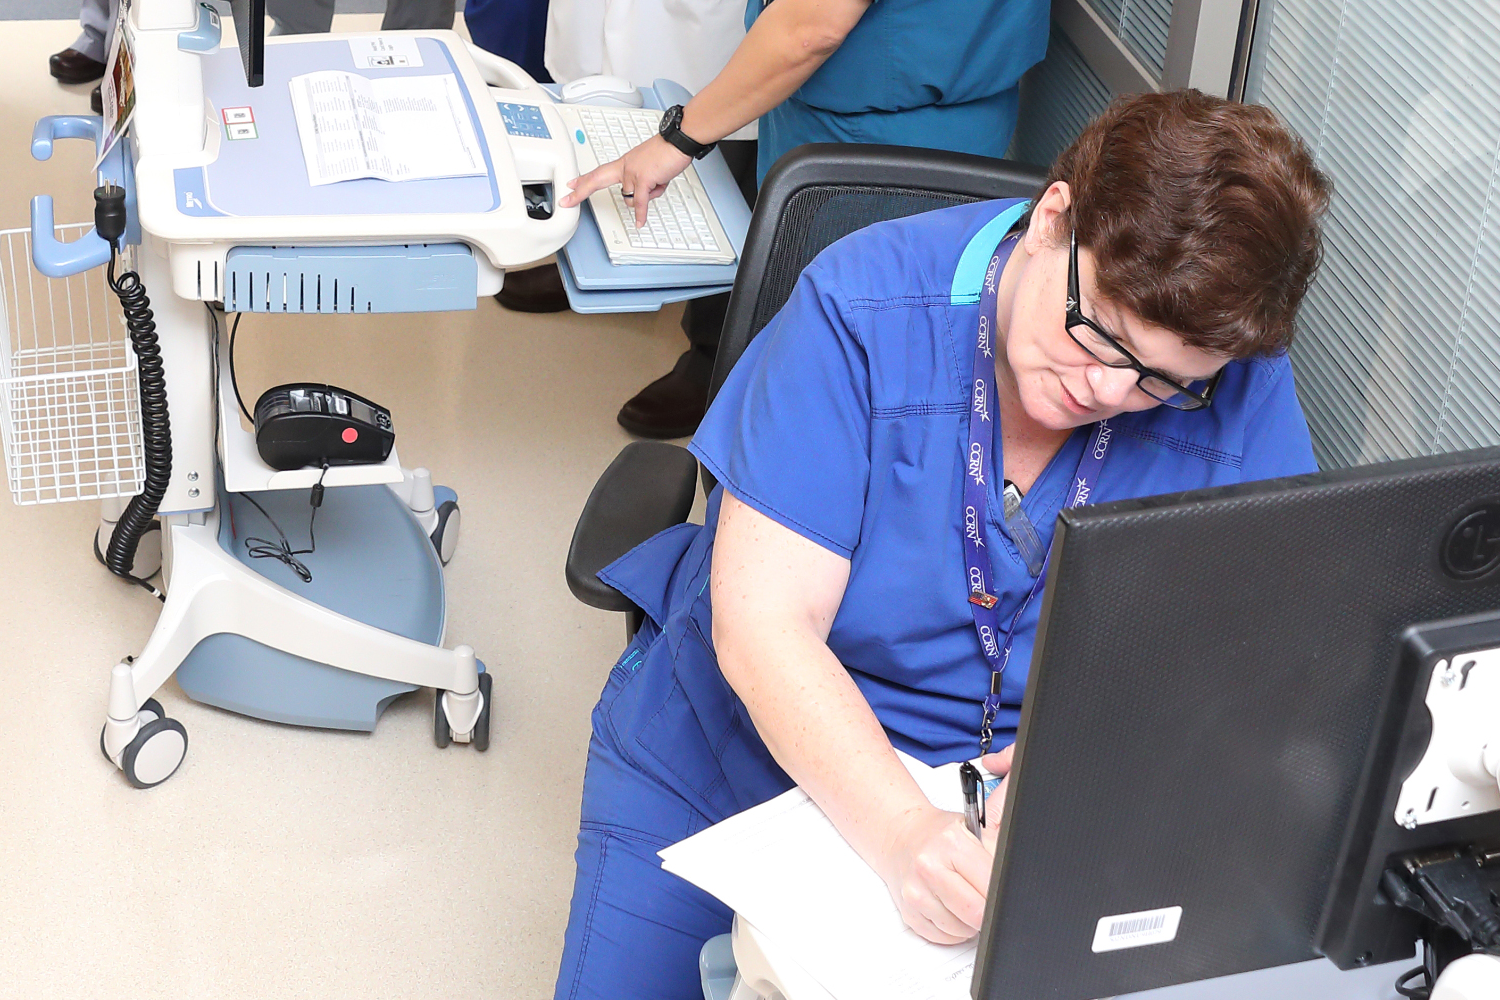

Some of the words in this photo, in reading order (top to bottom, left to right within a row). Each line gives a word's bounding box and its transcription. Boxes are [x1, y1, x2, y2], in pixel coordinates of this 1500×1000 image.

[984, 255, 1000, 288] CCRN
[977, 315, 988, 352] CCRN
[973, 378, 986, 415] CCRN
[968, 442, 981, 478] CCRN
[1094, 425, 1113, 460] CCRN
[965, 505, 977, 541] CCRN
[969, 566, 982, 592] CCR
[980, 625, 998, 659] CCRN
